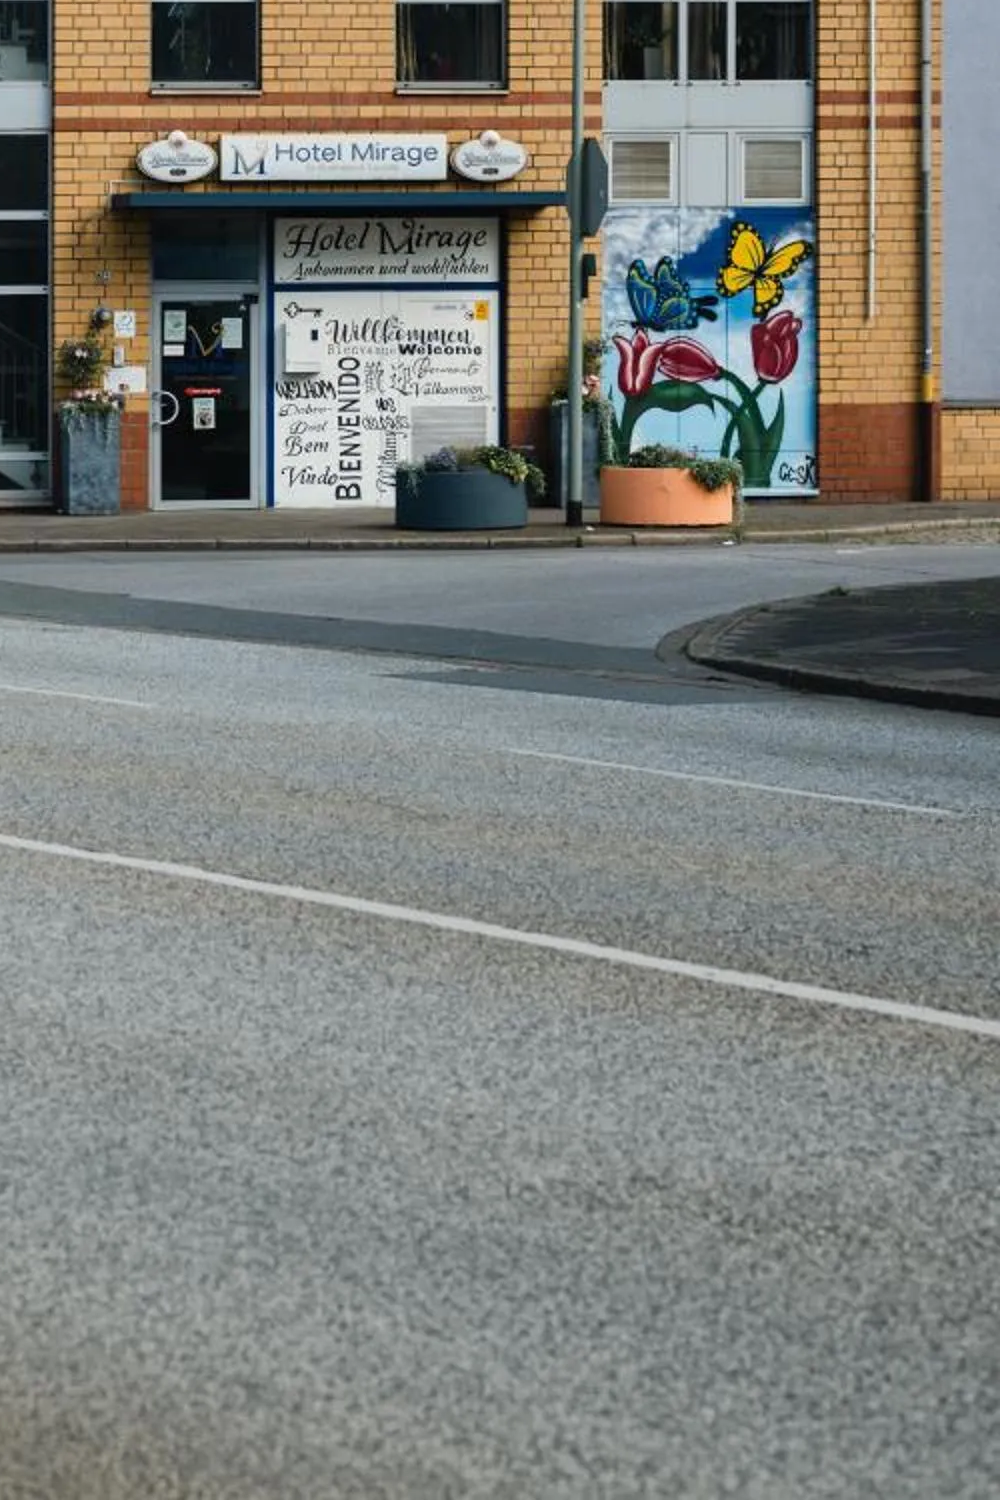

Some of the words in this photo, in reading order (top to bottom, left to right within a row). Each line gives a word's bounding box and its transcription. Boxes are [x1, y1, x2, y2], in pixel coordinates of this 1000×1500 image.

[274, 142, 342, 163] Hotel
[351, 142, 438, 167] Mirage
[283, 220, 371, 259] Hotel
[375, 219, 488, 262] Mirage
[280, 261, 375, 281] Ankommen
[379, 259, 409, 276] und
[399, 343, 483, 356] Welcome
[335, 357, 362, 500] BIENVENIDO
